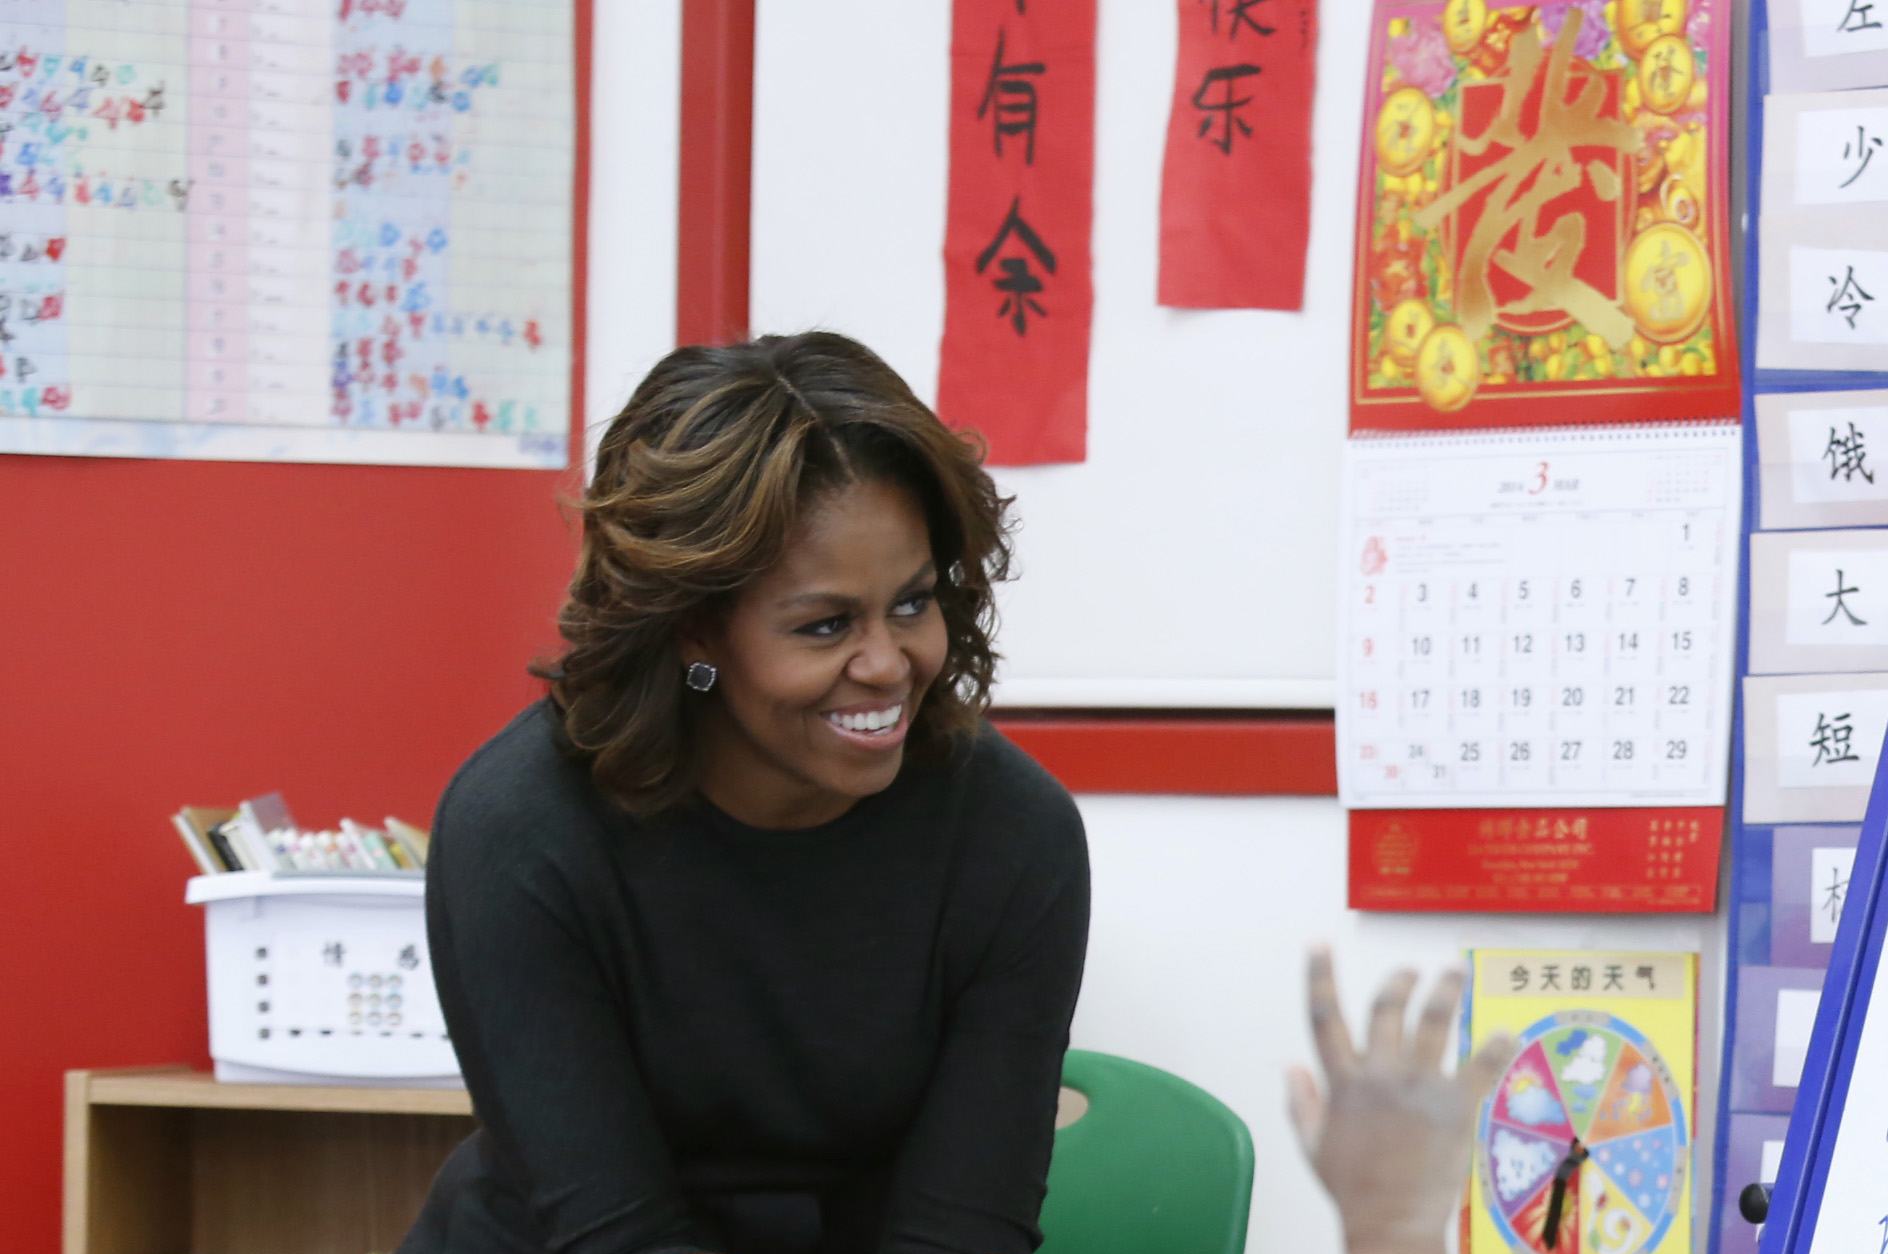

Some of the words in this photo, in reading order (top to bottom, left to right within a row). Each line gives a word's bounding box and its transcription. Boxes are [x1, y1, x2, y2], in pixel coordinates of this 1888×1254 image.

[975, 0, 1057, 336] 有余
[1840, 125, 1883, 188] 少
[1826, 266, 1875, 329] 冷
[1824, 422, 1874, 484] 饿
[1528, 460, 1549, 496] 3
[1683, 523, 1689, 540] 1
[1418, 583, 1427, 602] 3
[1468, 583, 1478, 599] 4
[1519, 580, 1529, 600] 5
[1571, 579, 1582, 599] 6
[1626, 577, 1636, 596] 7
[1679, 577, 1688, 596] 8
[1822, 569, 1867, 626] 大
[1413, 637, 1431, 656] 10
[1463, 636, 1480, 653] 11
[1514, 634, 1532, 653] 12
[1566, 633, 1585, 653] 13
[1619, 633, 1639, 649] 14
[1673, 630, 1691, 651] 15
[1412, 689, 1430, 707] 17
[1462, 689, 1480, 708] 18
[1513, 688, 1531, 707] 19
[1563, 687, 1583, 707] 20
[1615, 686, 1634, 706] 21
[1669, 686, 1689, 705] 22
[1461, 743, 1479, 762] 25
[1511, 742, 1530, 761] 26
[1561, 741, 1582, 761] 27
[1614, 741, 1633, 760] 28
[1667, 740, 1687, 759] 29
[1809, 713, 1860, 766] 短
[1511, 964, 1655, 991] 今天的天气
